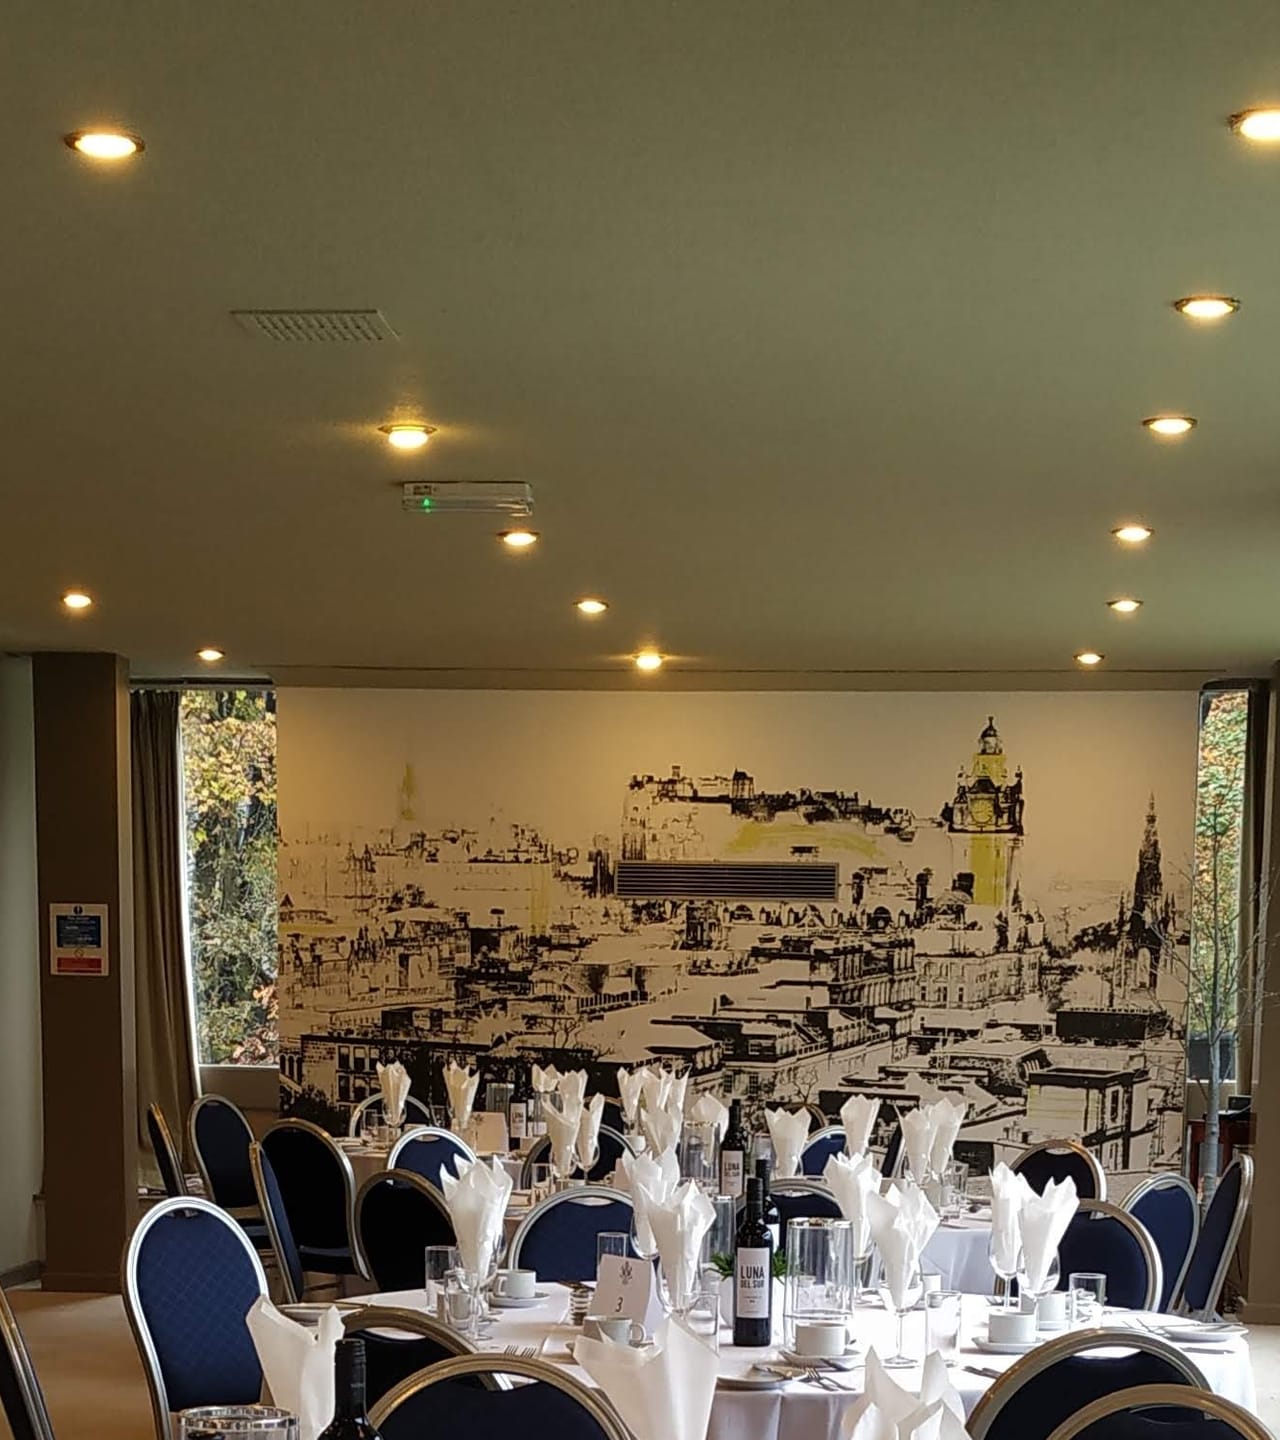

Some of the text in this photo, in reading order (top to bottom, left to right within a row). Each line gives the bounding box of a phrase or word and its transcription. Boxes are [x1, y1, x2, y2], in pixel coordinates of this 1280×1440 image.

[740, 1265, 765, 1280] LUNA
[740, 1279, 765, 1289] DEL SUR
[615, 1297, 624, 1313] 3
